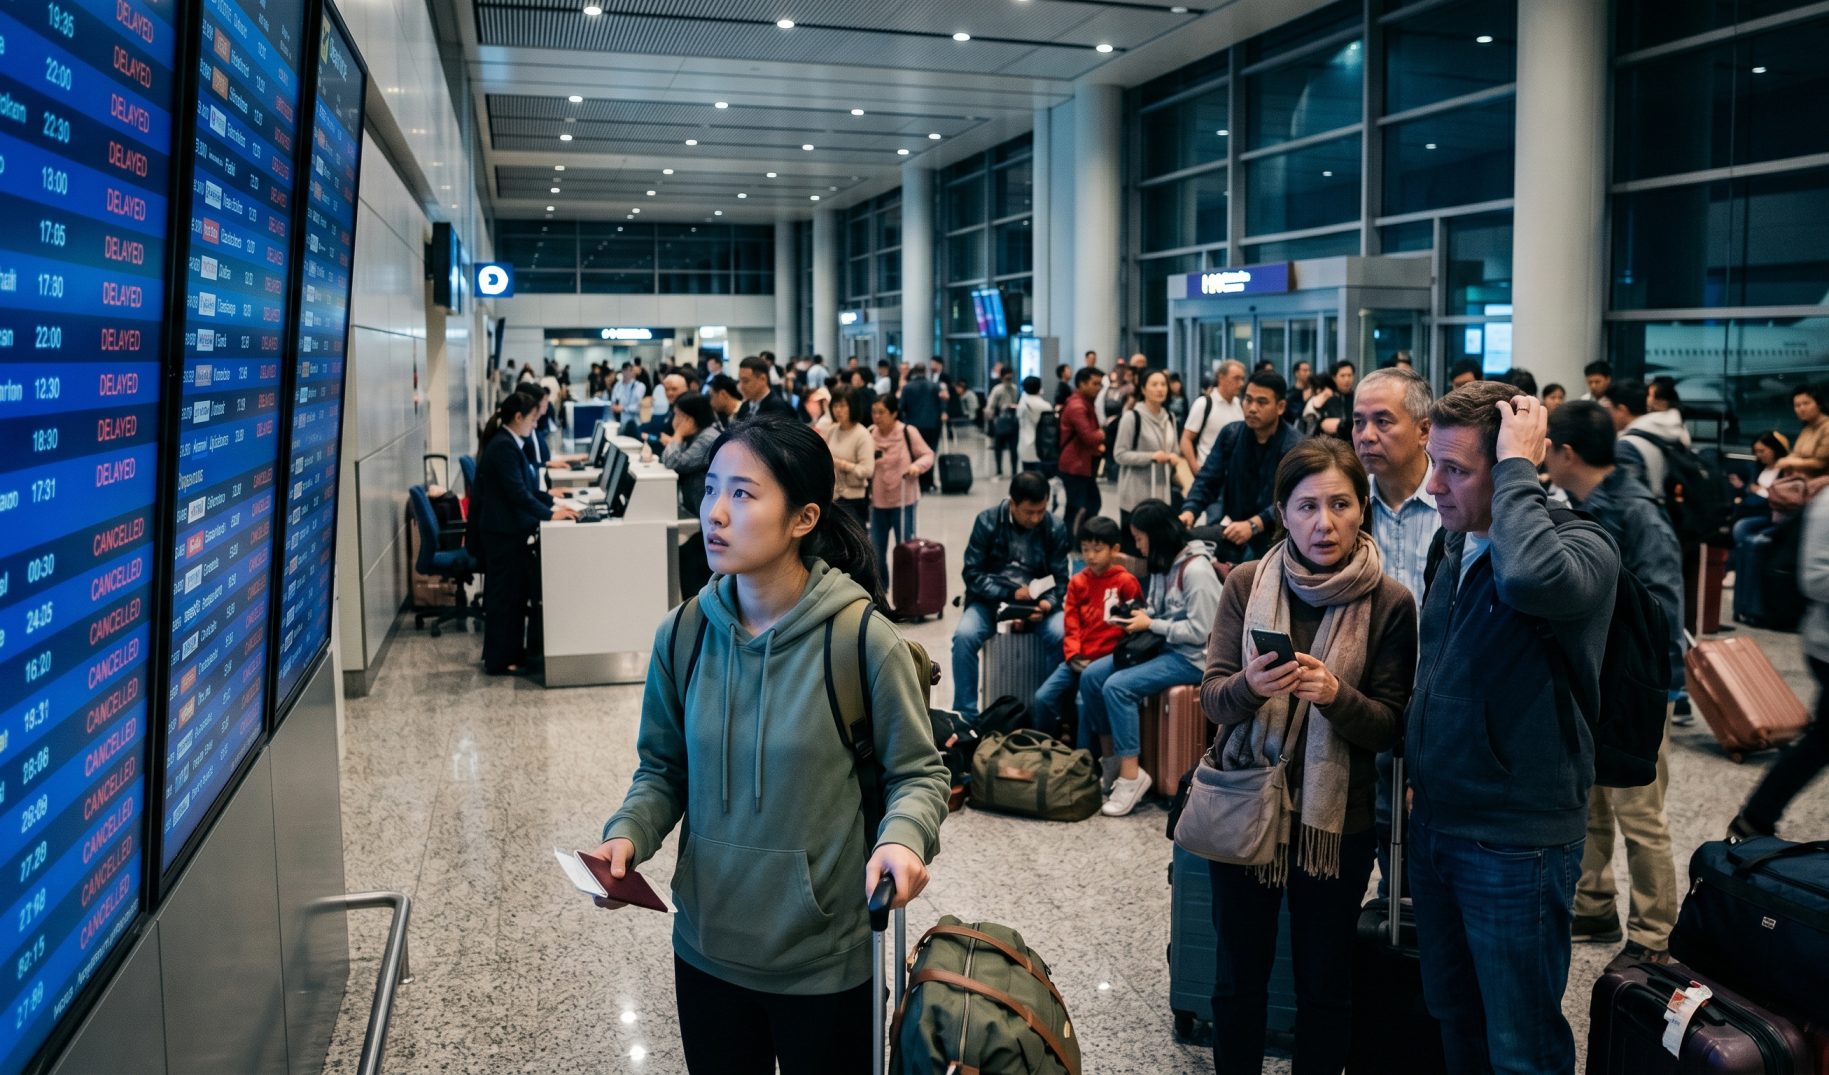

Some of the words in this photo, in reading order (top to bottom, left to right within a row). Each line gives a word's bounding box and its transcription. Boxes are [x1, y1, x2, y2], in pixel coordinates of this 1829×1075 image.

[117, 0, 153, 43] DELAYED
[113, 46, 151, 89] DELAYED
[46, 57, 72, 91] 22:00
[111, 93, 149, 133] DELAYED
[108, 141, 147, 177] DELAYED
[106, 188, 145, 221] DELAYED
[105, 236, 144, 265] DELAYED
[103, 282, 142, 307] DELAYED
[35, 326, 61, 349] 22:00
[101, 328, 140, 350] DELAYED
[99, 373, 138, 396] DELAYED
[33, 428, 58, 452] 18:30
[97, 415, 137, 442] DELAYED
[96, 457, 135, 488] DELAYED
[93, 517, 145, 557] CANCELLED
[91, 557, 142, 601] CANCELLED
[89, 598, 141, 646] CANCELLED
[88, 637, 139, 690] CANCELLED
[86, 677, 138, 734] CANCELLED
[84, 717, 136, 777] CANCELLED
[84, 756, 135, 821] CANCELLED
[82, 797, 133, 864] CANCELLED
[81, 835, 132, 907] CANCELLED
[80, 873, 130, 950] CANCELLED
